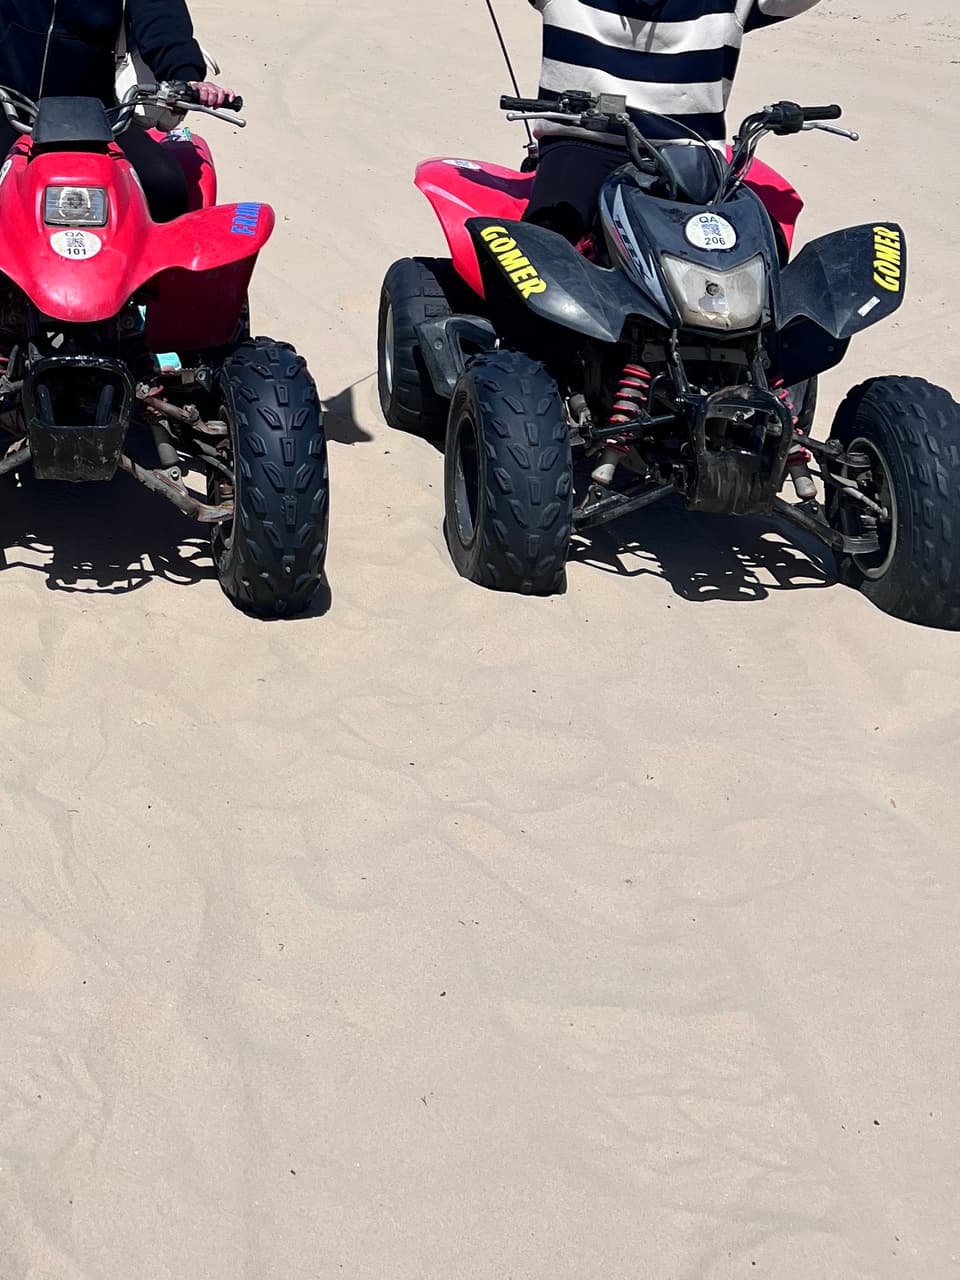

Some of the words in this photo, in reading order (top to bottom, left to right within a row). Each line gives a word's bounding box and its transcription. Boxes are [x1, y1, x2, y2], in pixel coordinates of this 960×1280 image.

[698, 215, 719, 223] QA
[704, 236, 726, 246] 206
[66, 247, 87, 256] 101
[480, 225, 547, 299] GOMER
[872, 225, 901, 292] GOMER
